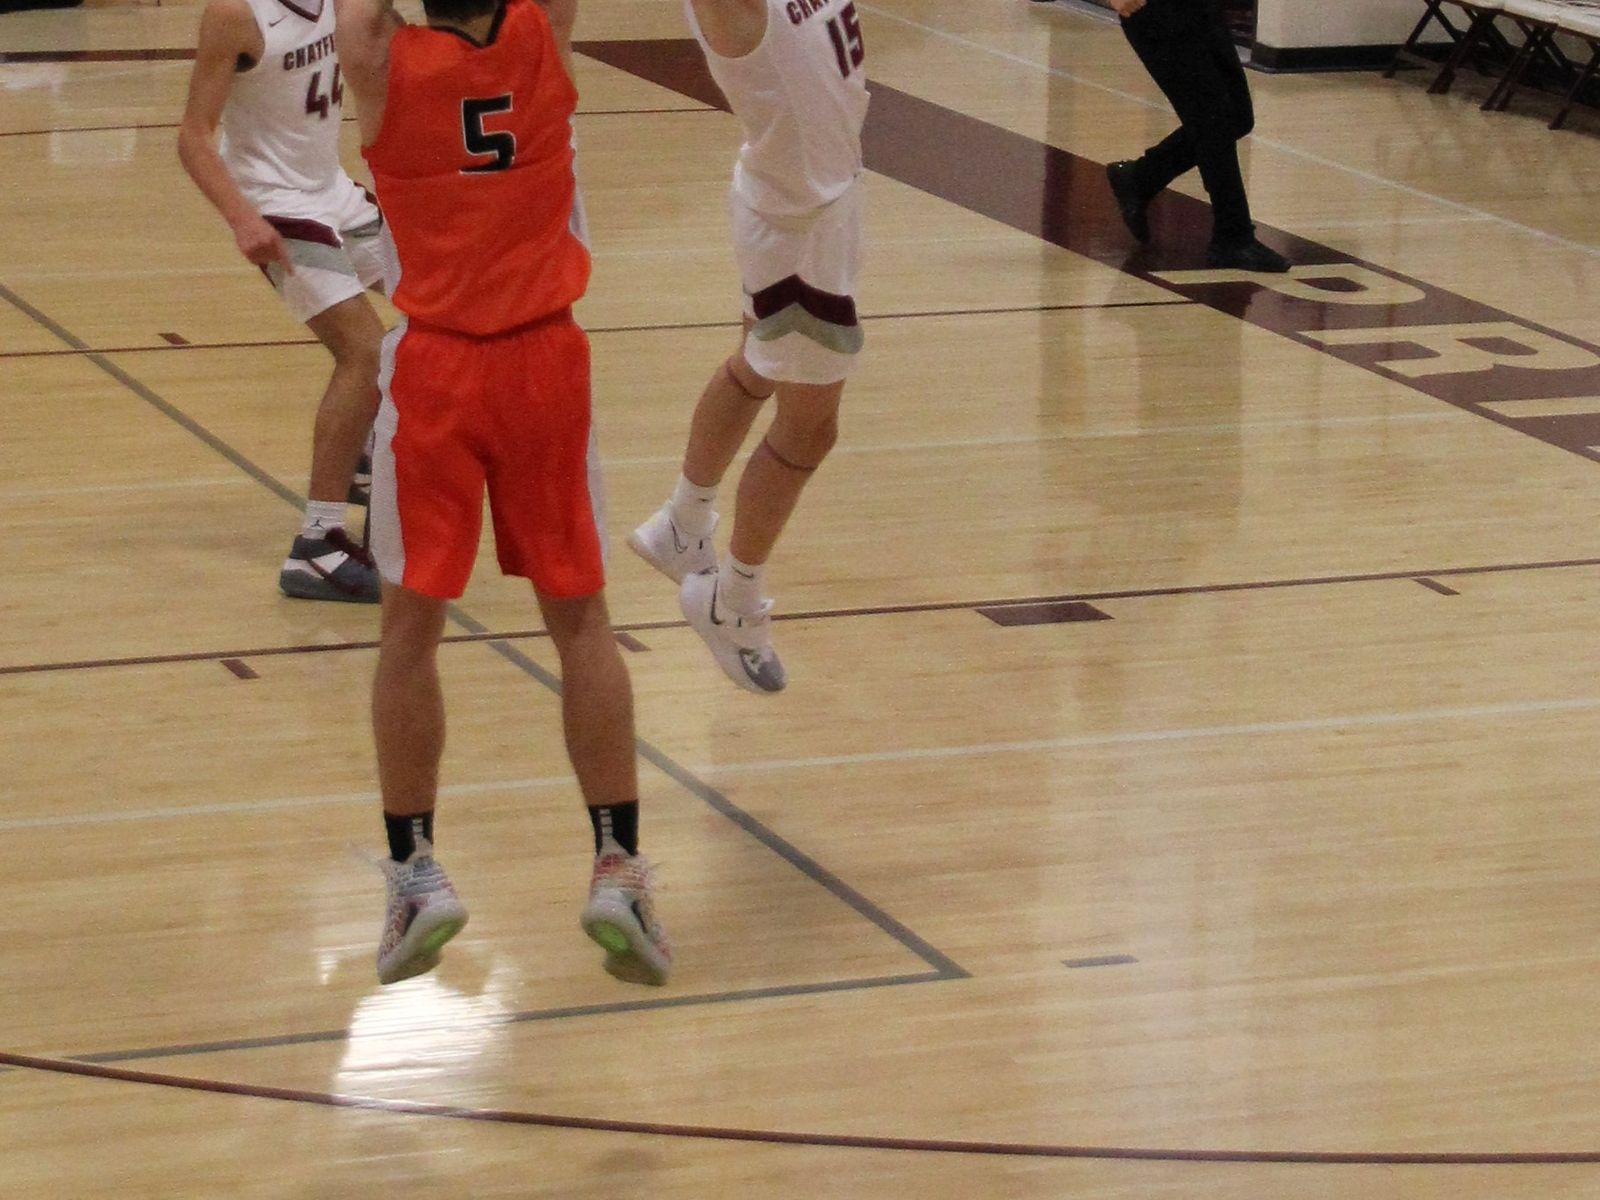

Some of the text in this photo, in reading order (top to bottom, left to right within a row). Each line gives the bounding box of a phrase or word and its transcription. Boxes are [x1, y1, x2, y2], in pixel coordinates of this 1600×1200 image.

[283, 33, 335, 71] CHATFI
[825, 1, 865, 81] 15
[459, 90, 517, 176] 5
